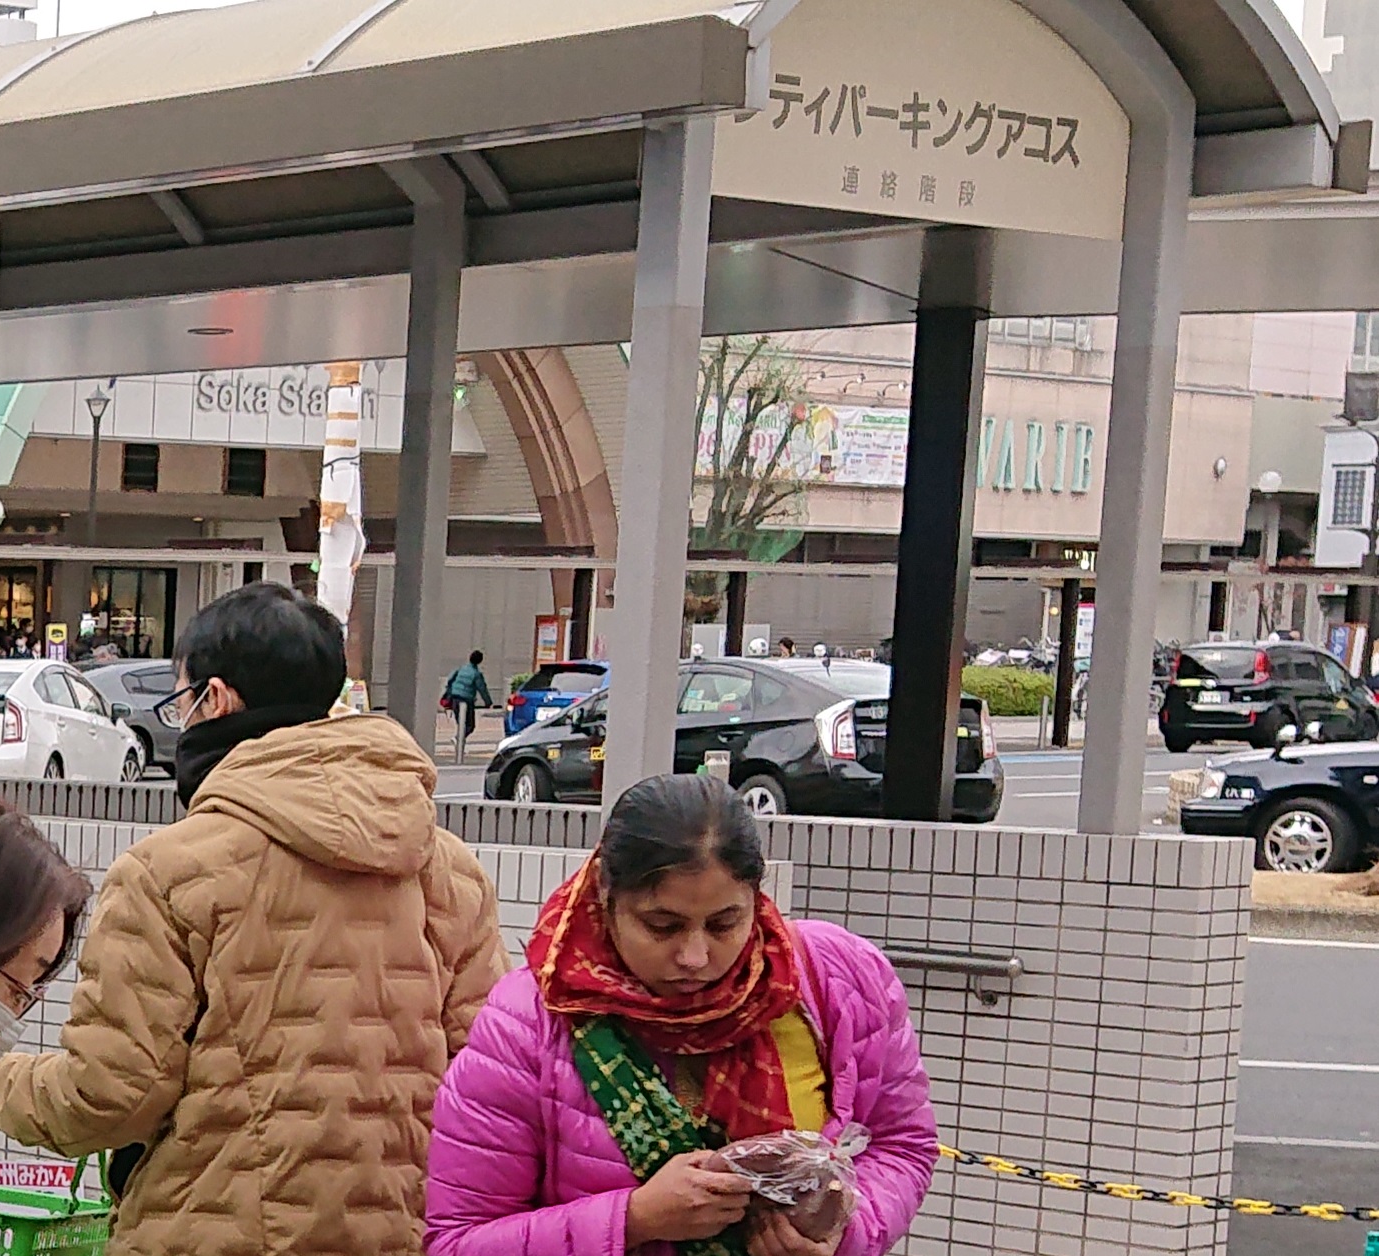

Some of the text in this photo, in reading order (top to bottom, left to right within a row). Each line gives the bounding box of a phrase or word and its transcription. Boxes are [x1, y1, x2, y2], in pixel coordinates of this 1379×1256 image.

[734, 72, 1081, 168] ティパーキングアコス
[841, 165, 977, 208] 連絡階段
[196, 374, 270, 414] Soka
